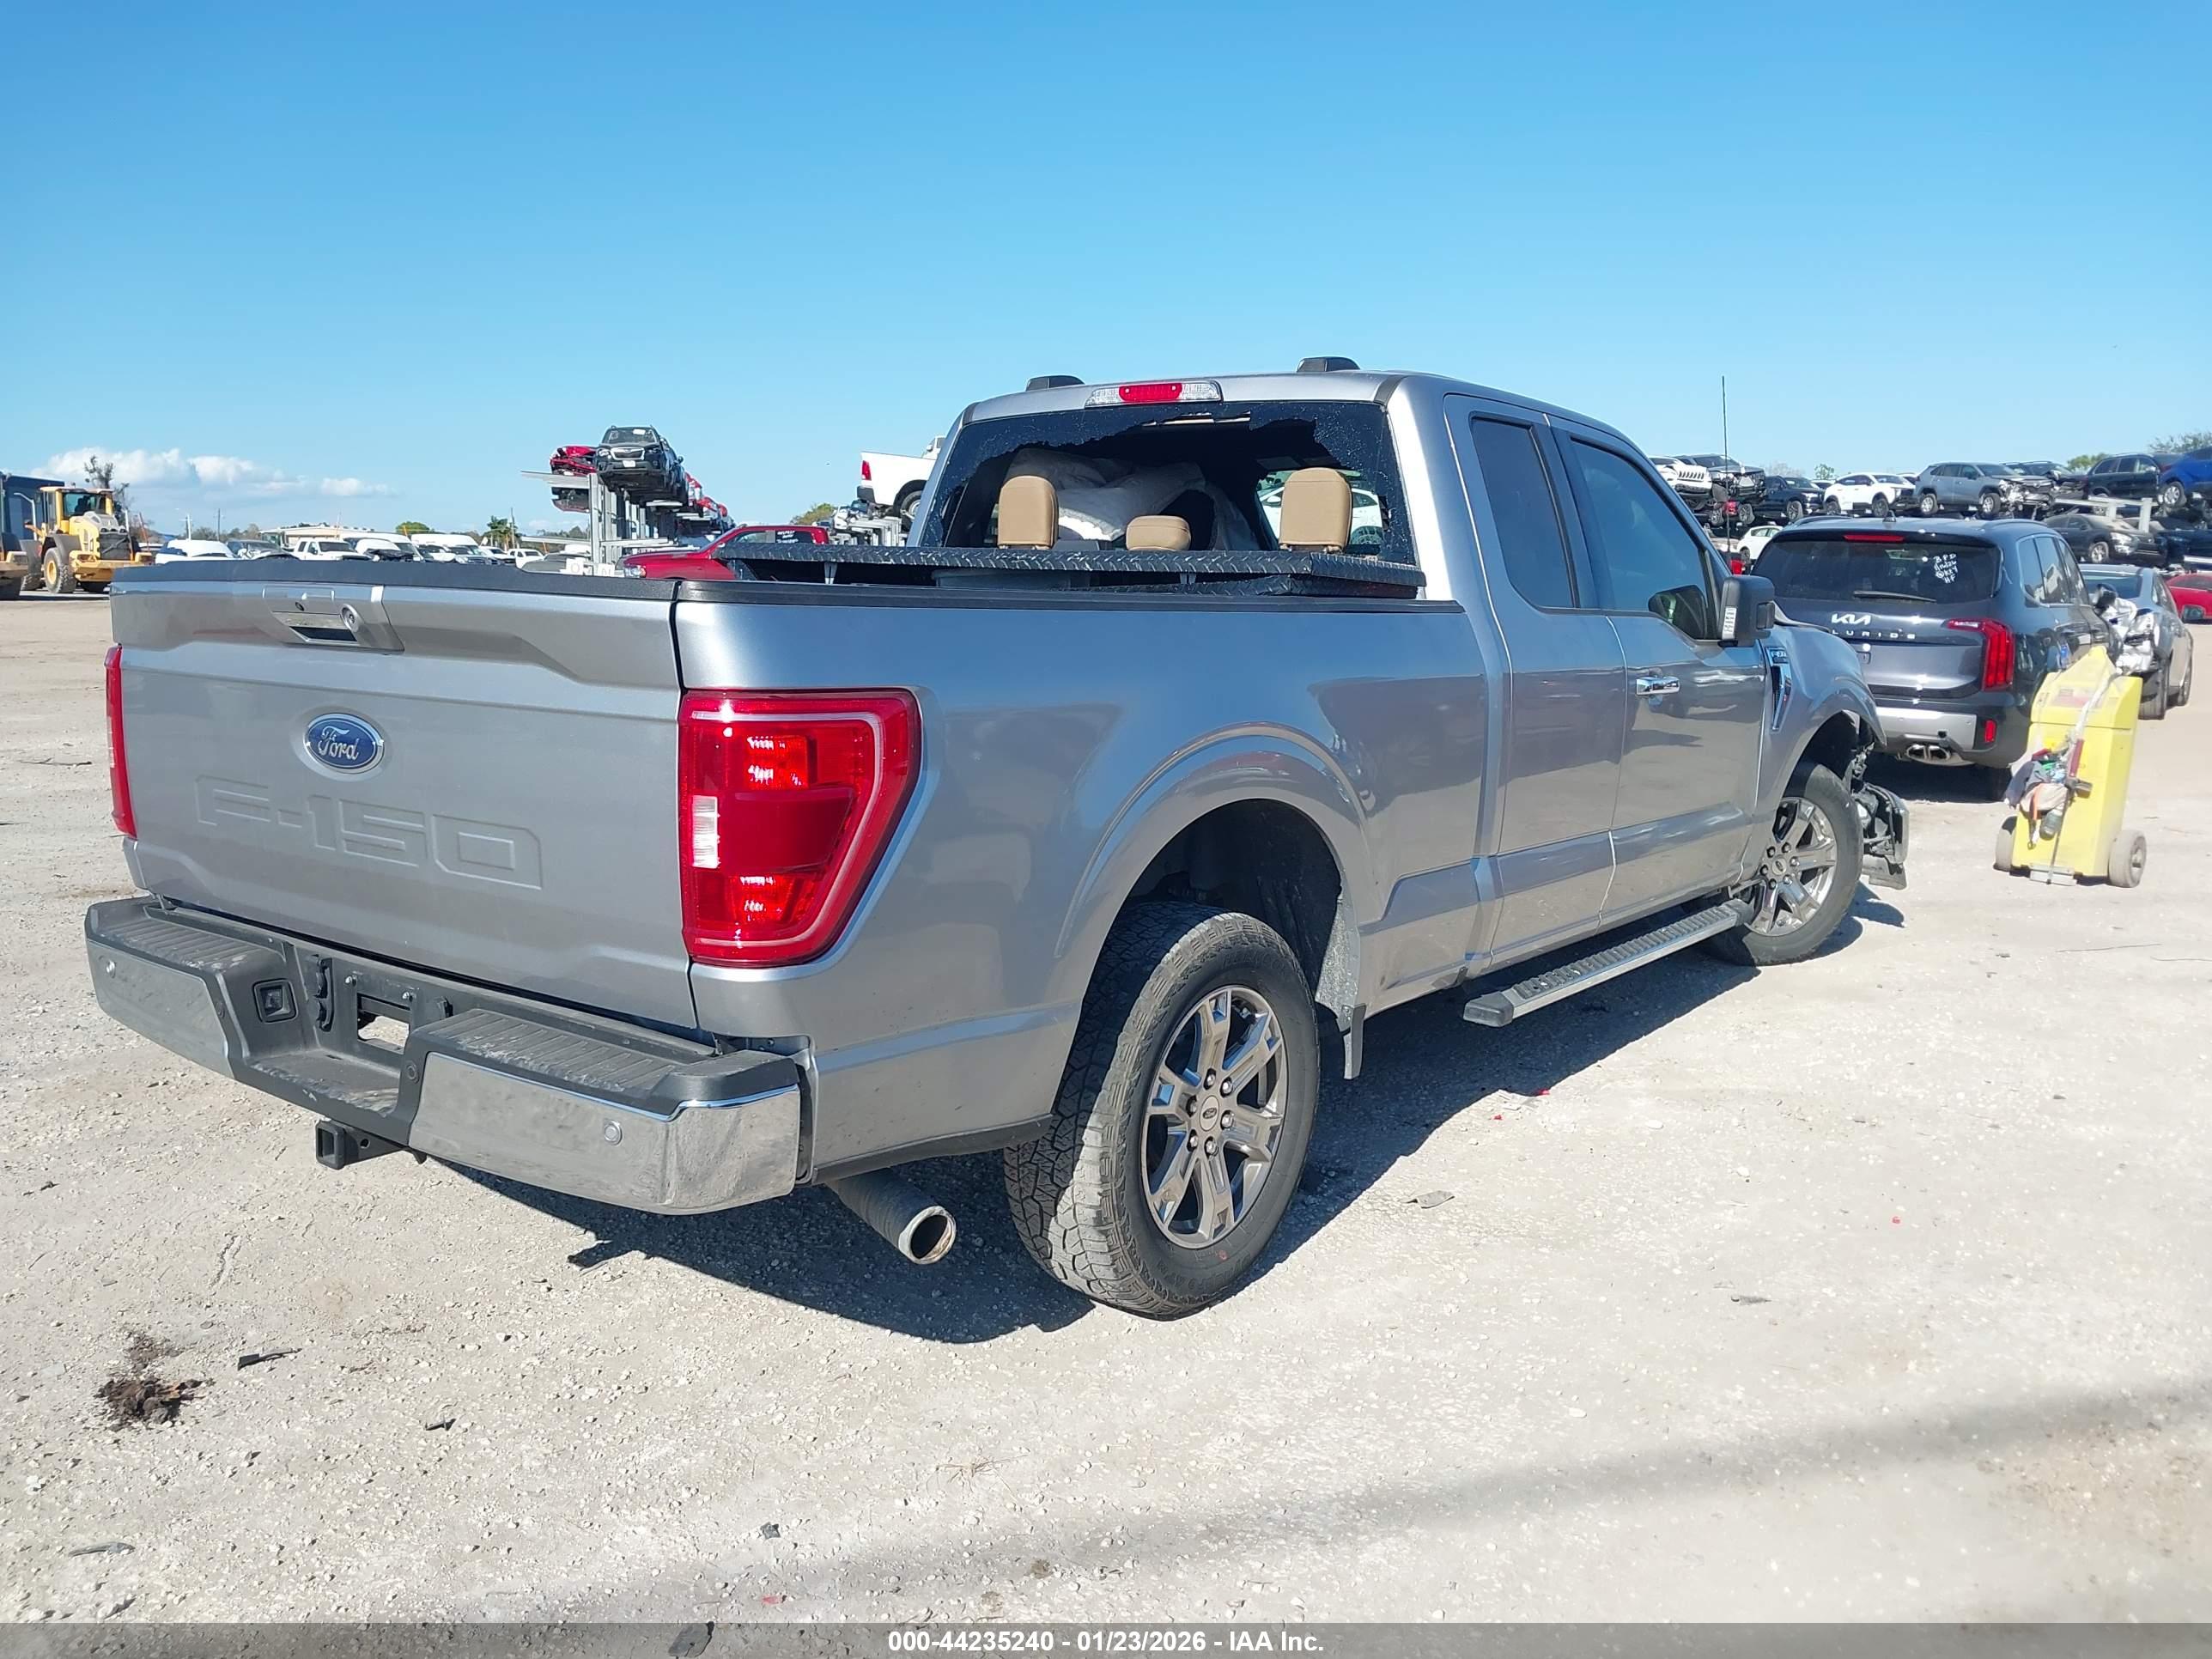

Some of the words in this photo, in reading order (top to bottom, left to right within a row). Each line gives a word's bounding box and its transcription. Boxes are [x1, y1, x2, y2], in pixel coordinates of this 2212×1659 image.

[1832, 629, 1916, 640] LURIDE
[318, 725, 361, 761] Ford
[194, 774, 543, 890] F-150
